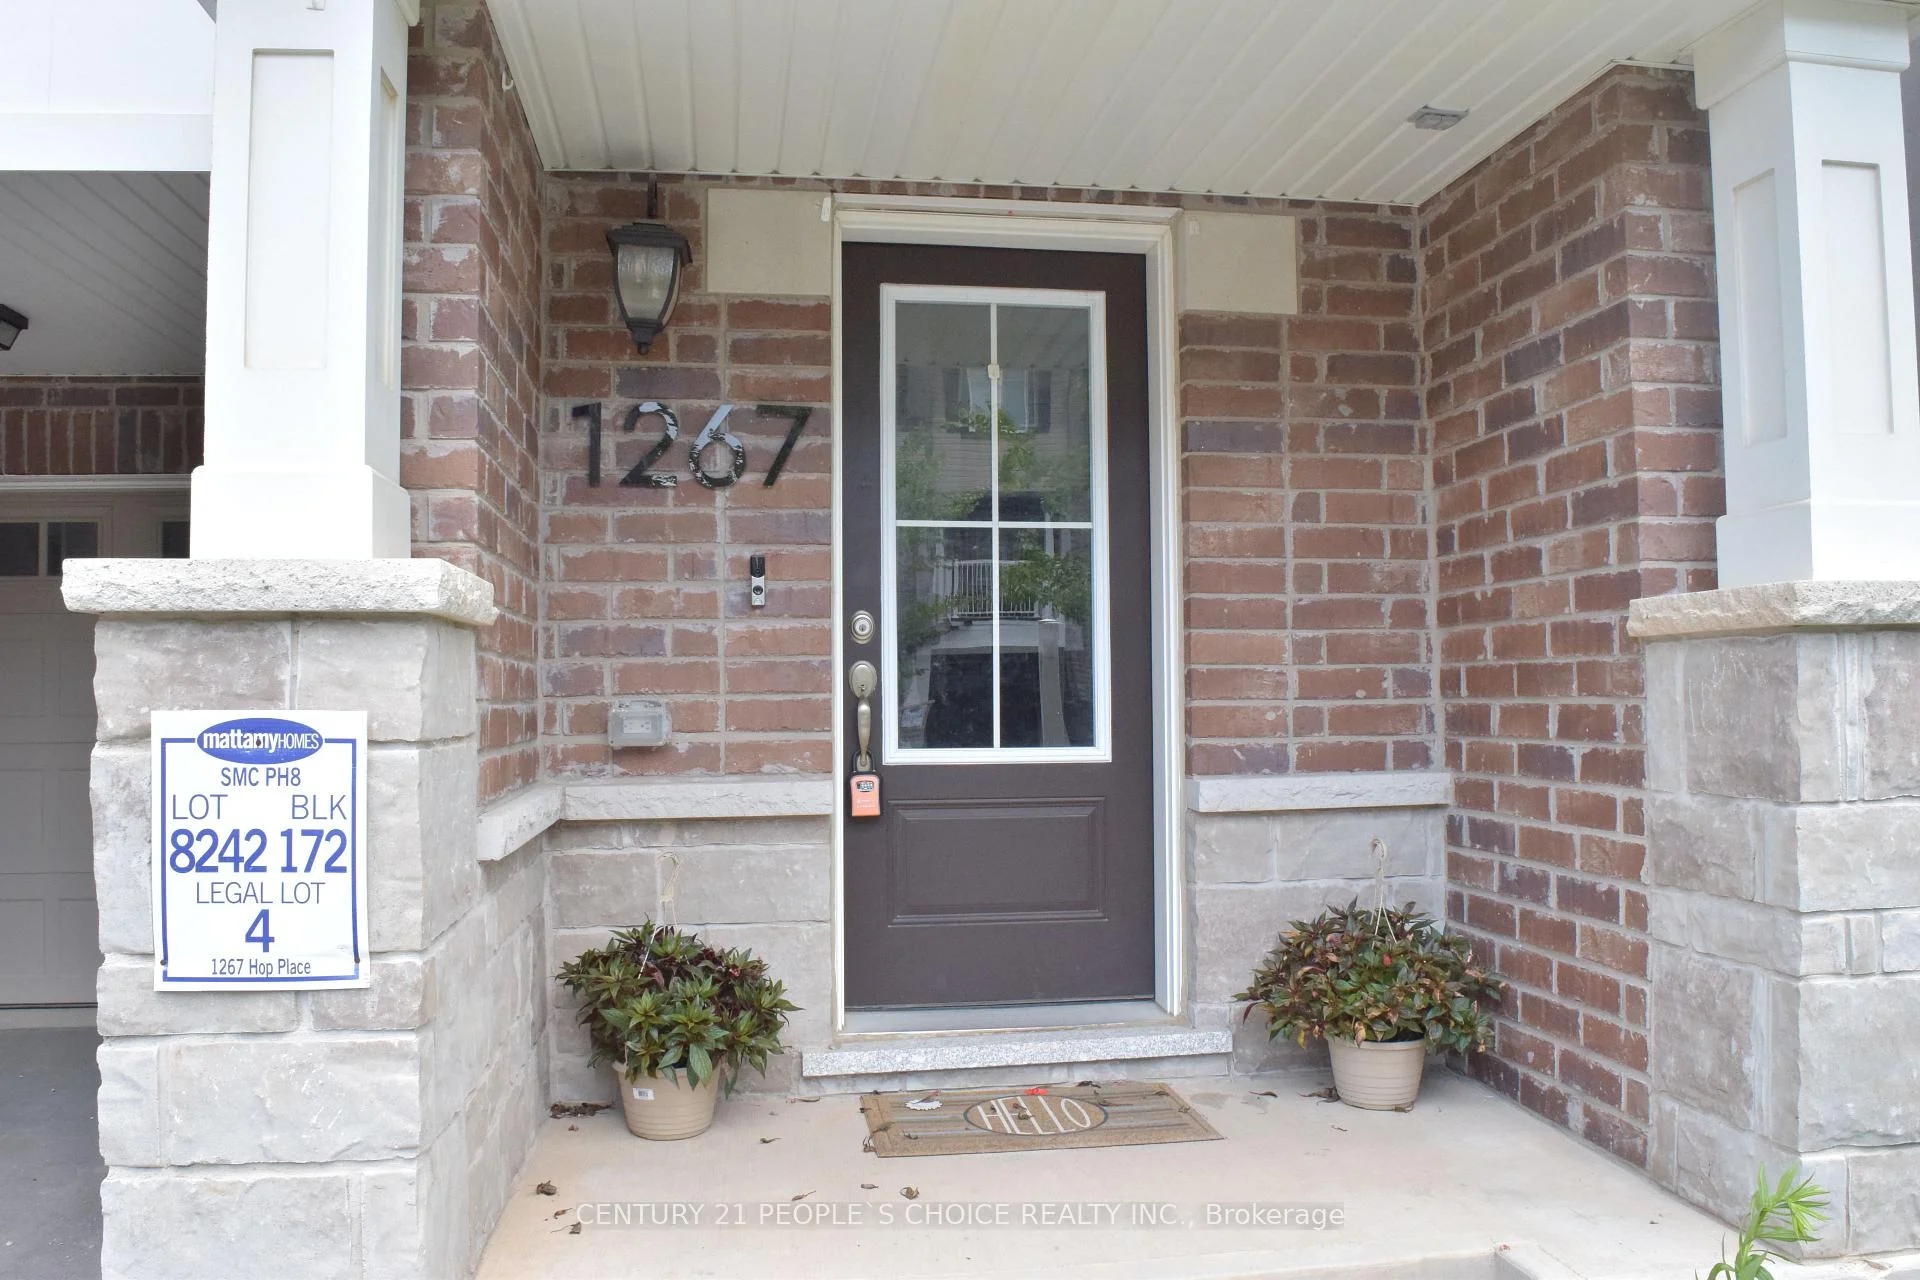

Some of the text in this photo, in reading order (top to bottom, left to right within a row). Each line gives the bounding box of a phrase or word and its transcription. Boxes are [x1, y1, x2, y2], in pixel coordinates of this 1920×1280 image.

[571, 400, 814, 489] 1267
[220, 766, 302, 787] SMC PH8
[172, 794, 228, 820] LOT
[291, 794, 347, 820] BLK
[169, 828, 268, 874] 8242
[280, 828, 348, 874] 172
[195, 881, 326, 904] LEGAL LOT
[244, 908, 276, 953] 4
[211, 957, 312, 979] 1267 Hop Place
[976, 1095, 1091, 1135] HELLO
